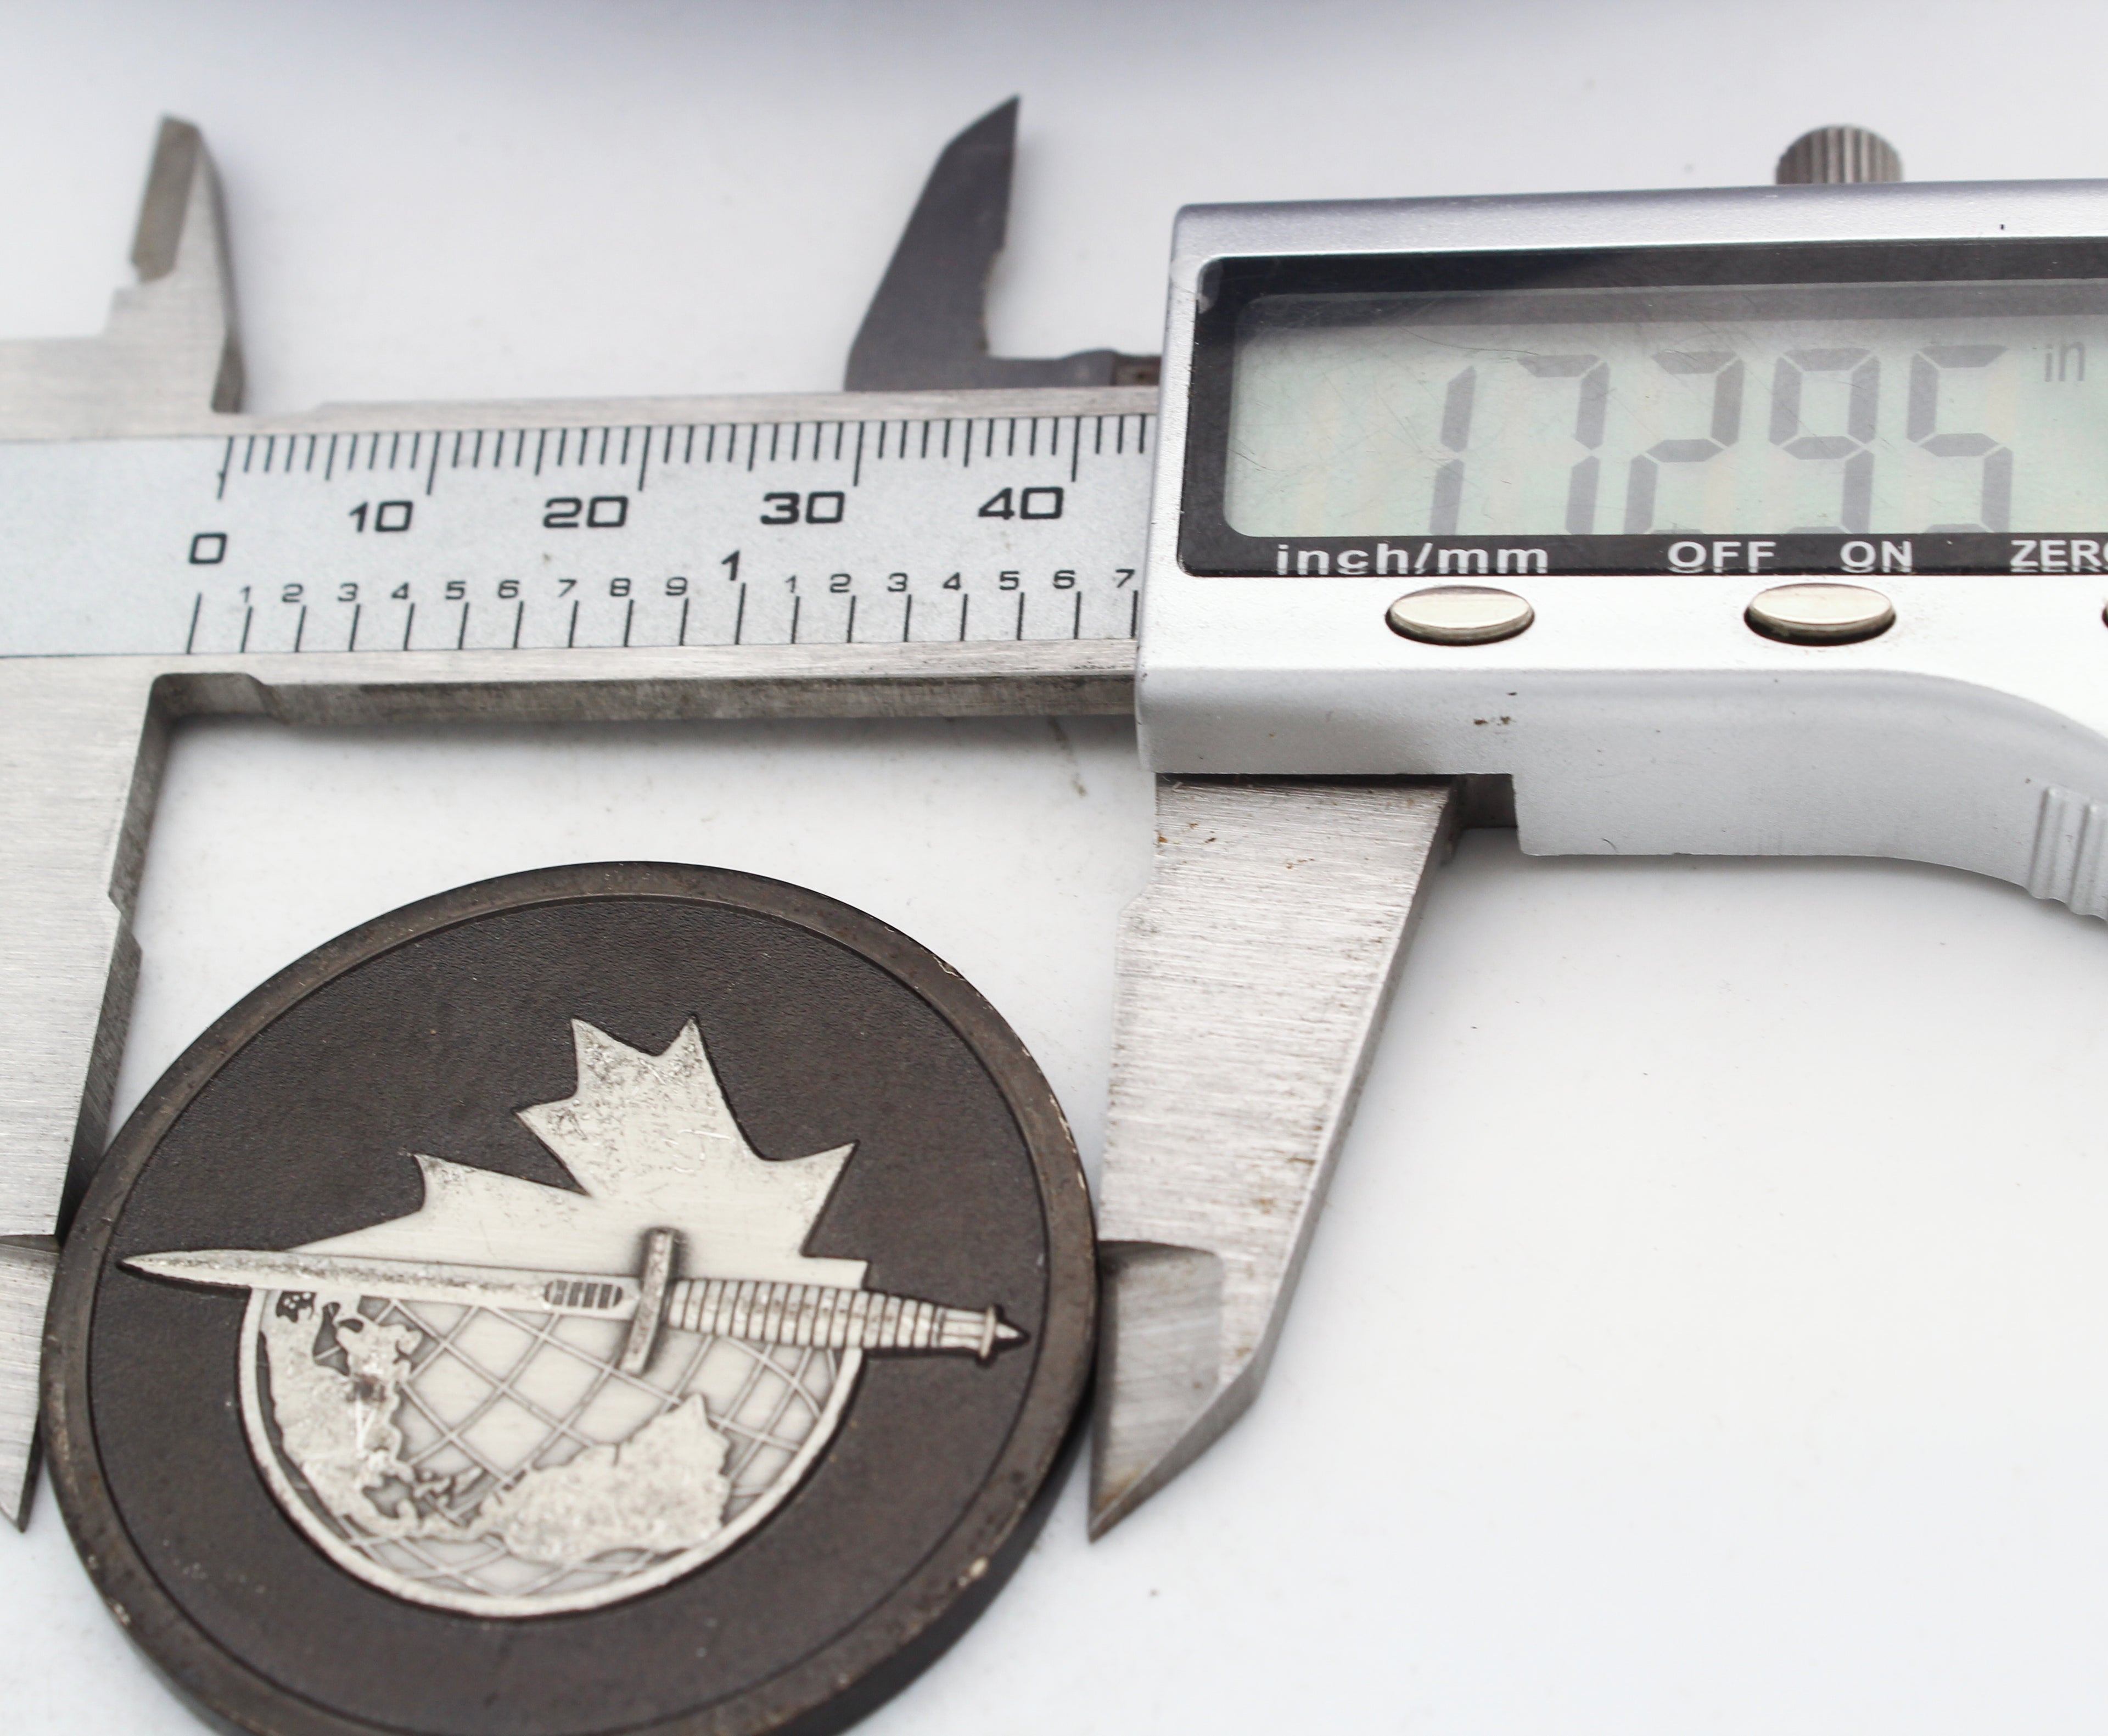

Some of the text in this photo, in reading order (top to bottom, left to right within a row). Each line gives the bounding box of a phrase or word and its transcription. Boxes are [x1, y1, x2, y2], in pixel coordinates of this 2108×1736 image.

[2044, 340, 2085, 383] in
[188, 486, 1064, 565] 0 10 20 30 40
[1276, 542, 1549, 575] inch/mm
[1667, 540, 1777, 573] OFF
[1840, 540, 1913, 573] ON
[2009, 539, 2108, 572] ZER
[240, 550, 1136, 603] 1 2 3 4 5 6 7 8 9 1 1 2 3 4 5 6 7
